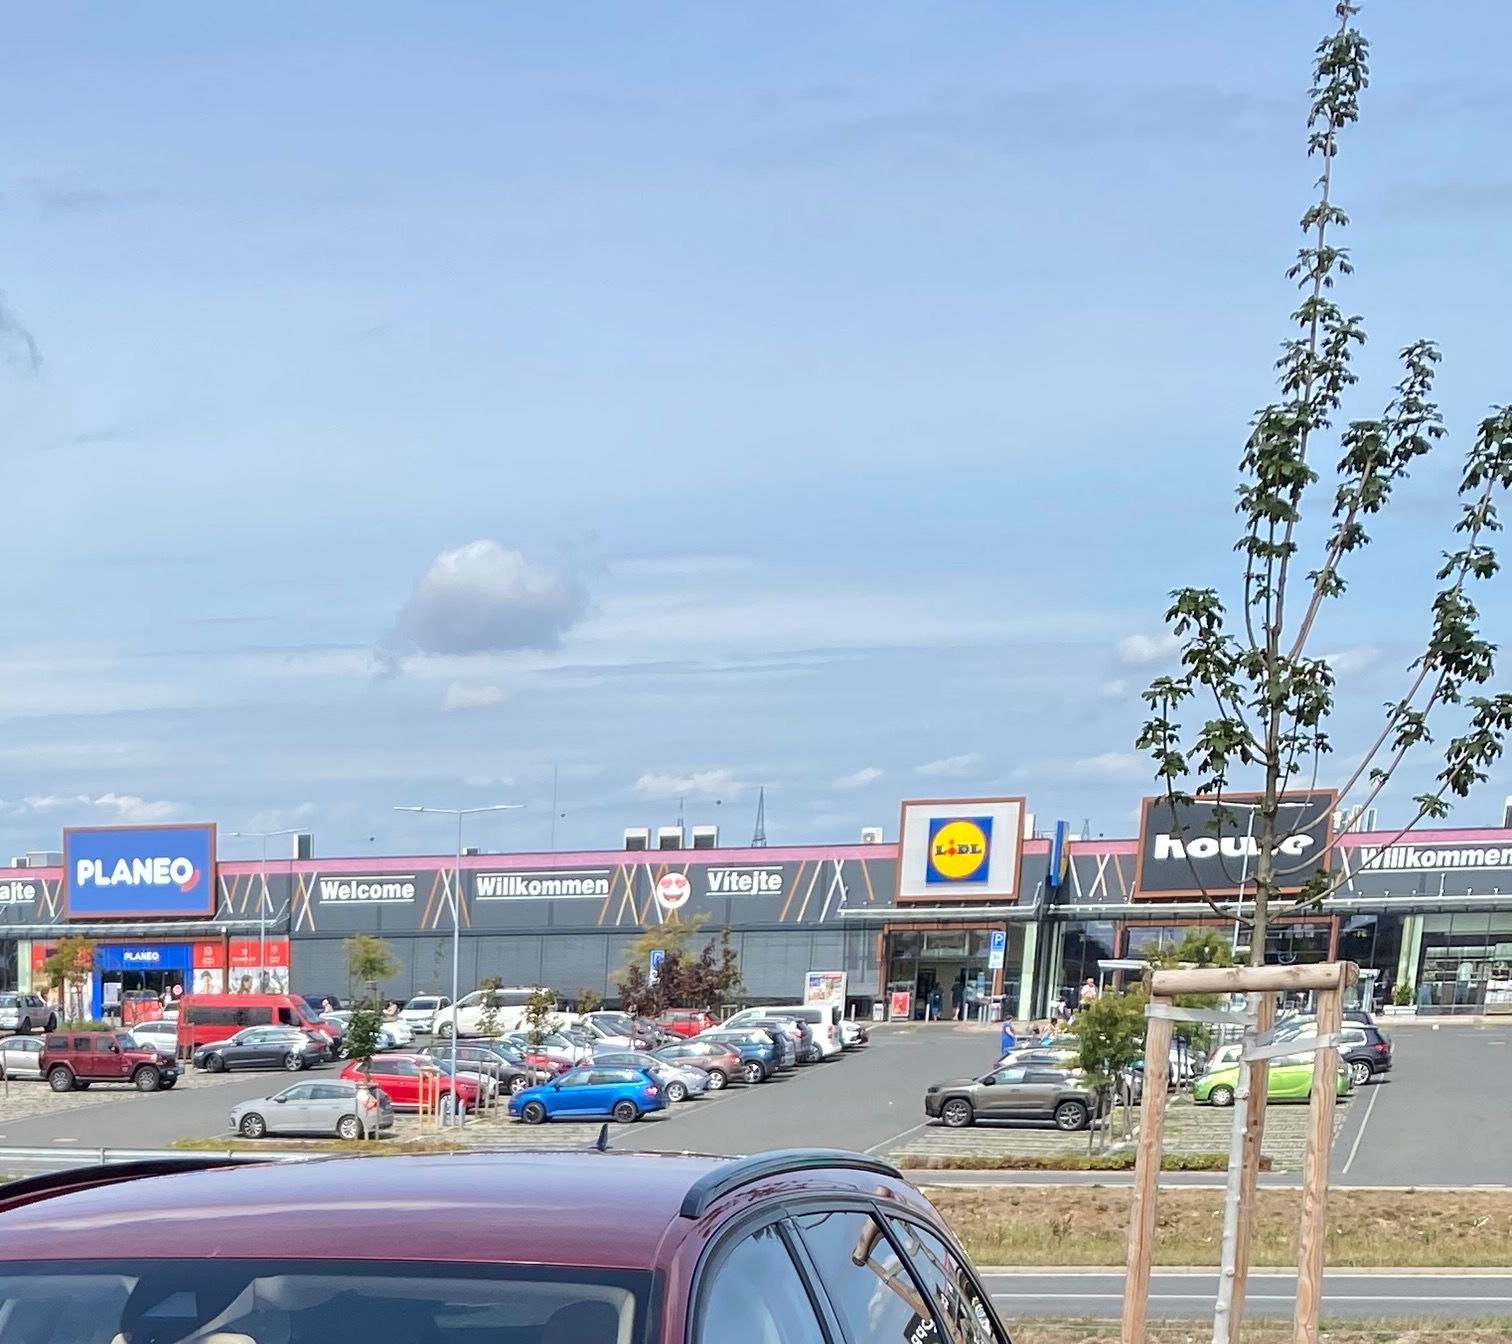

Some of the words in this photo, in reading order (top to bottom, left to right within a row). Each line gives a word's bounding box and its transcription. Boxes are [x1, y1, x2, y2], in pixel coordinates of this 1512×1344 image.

[1154, 833, 1314, 858] houe
[76, 857, 194, 886] PLANEO
[708, 871, 783, 895] Vítejte
[319, 879, 415, 900] Welcome
[476, 876, 609, 897] Willkommen
